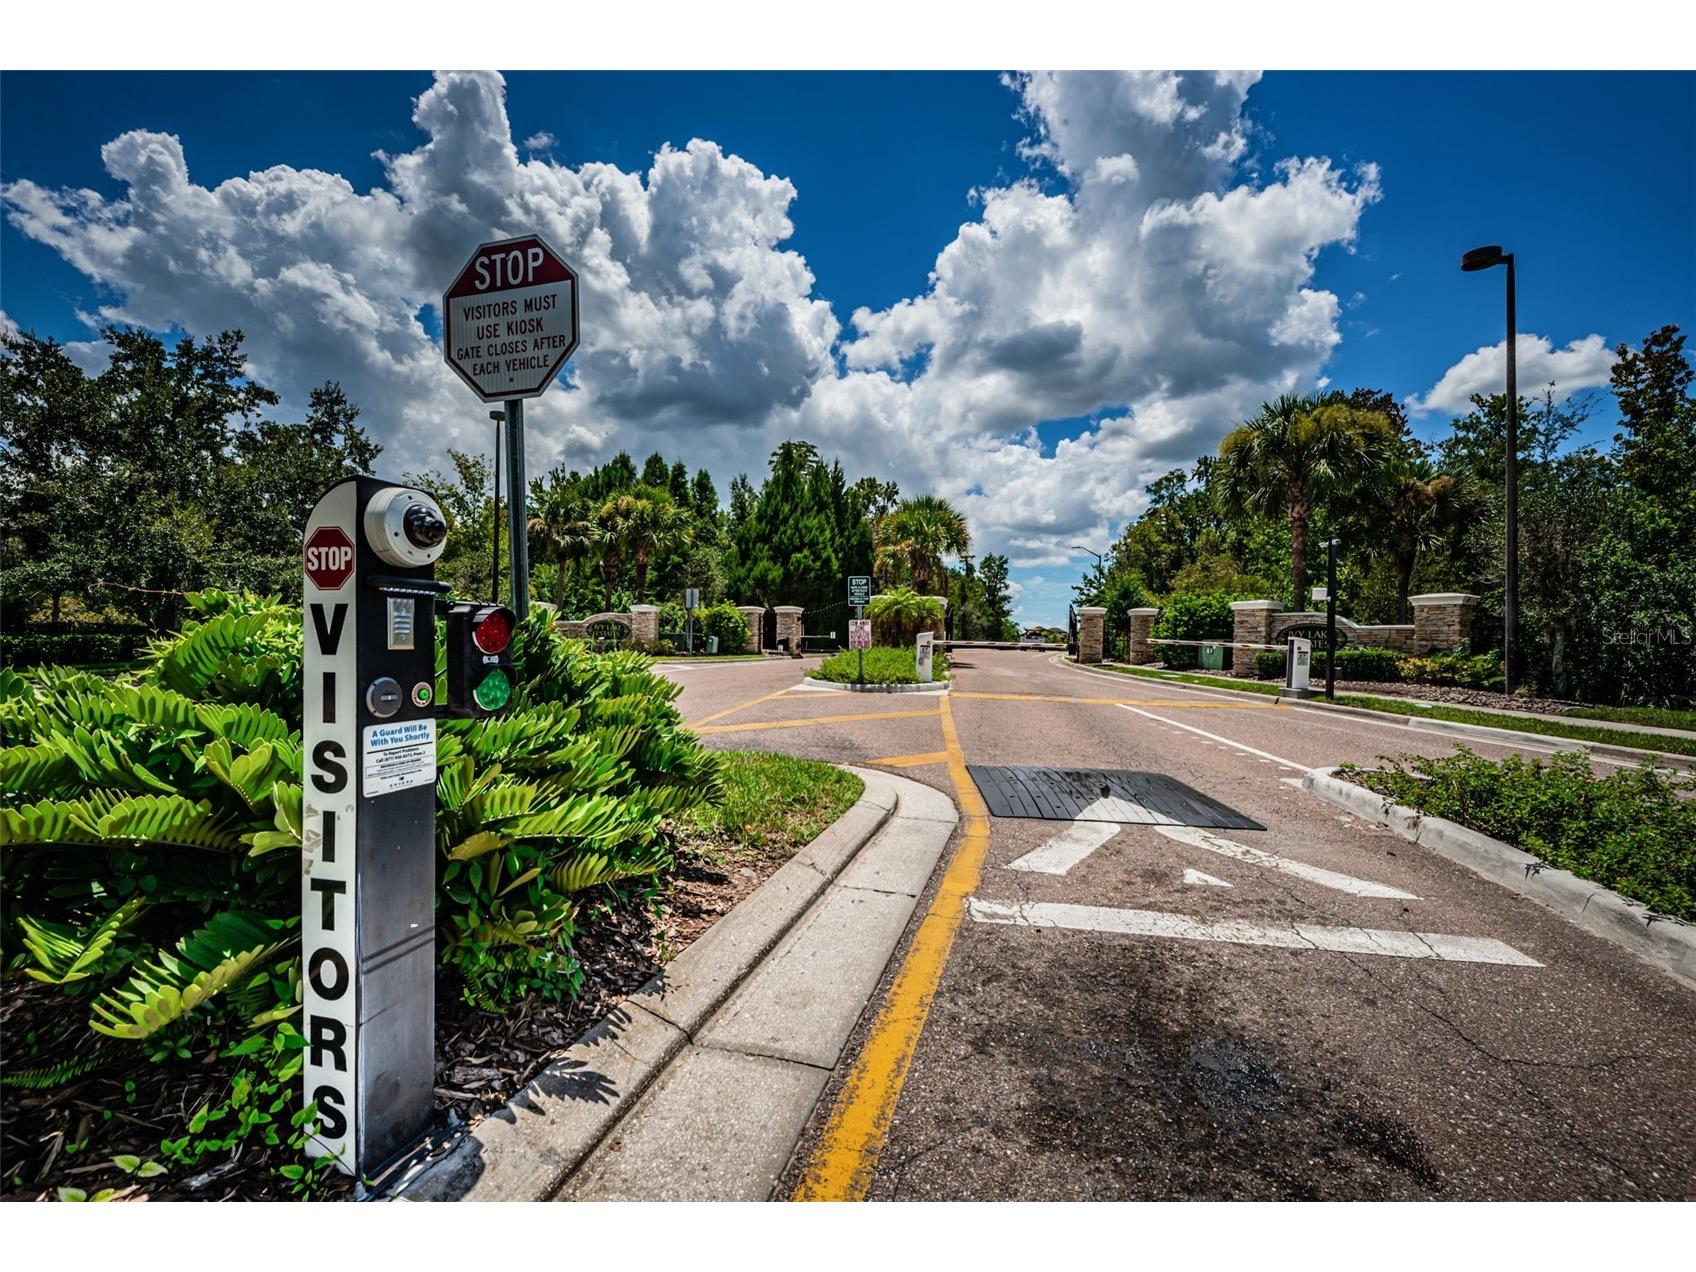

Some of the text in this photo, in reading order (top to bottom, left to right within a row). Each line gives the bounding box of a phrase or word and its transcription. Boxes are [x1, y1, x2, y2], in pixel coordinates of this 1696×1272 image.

[474, 247, 544, 291] STOP
[463, 294, 558, 321] VISITORS MUST
[476, 317, 544, 340] USE KIOSK
[457, 335, 566, 361] GATE CLOSES AFTER
[472, 355, 549, 376] EACH VEHICLE
[306, 546, 352, 571] STOP
[852, 578, 867, 586] STOP
[1308, 630, 1329, 639] LAK
[370, 731, 430, 746] With You Shortly
[372, 723, 427, 738] A Guard Will Be
[308, 603, 350, 1140] VISITORS
